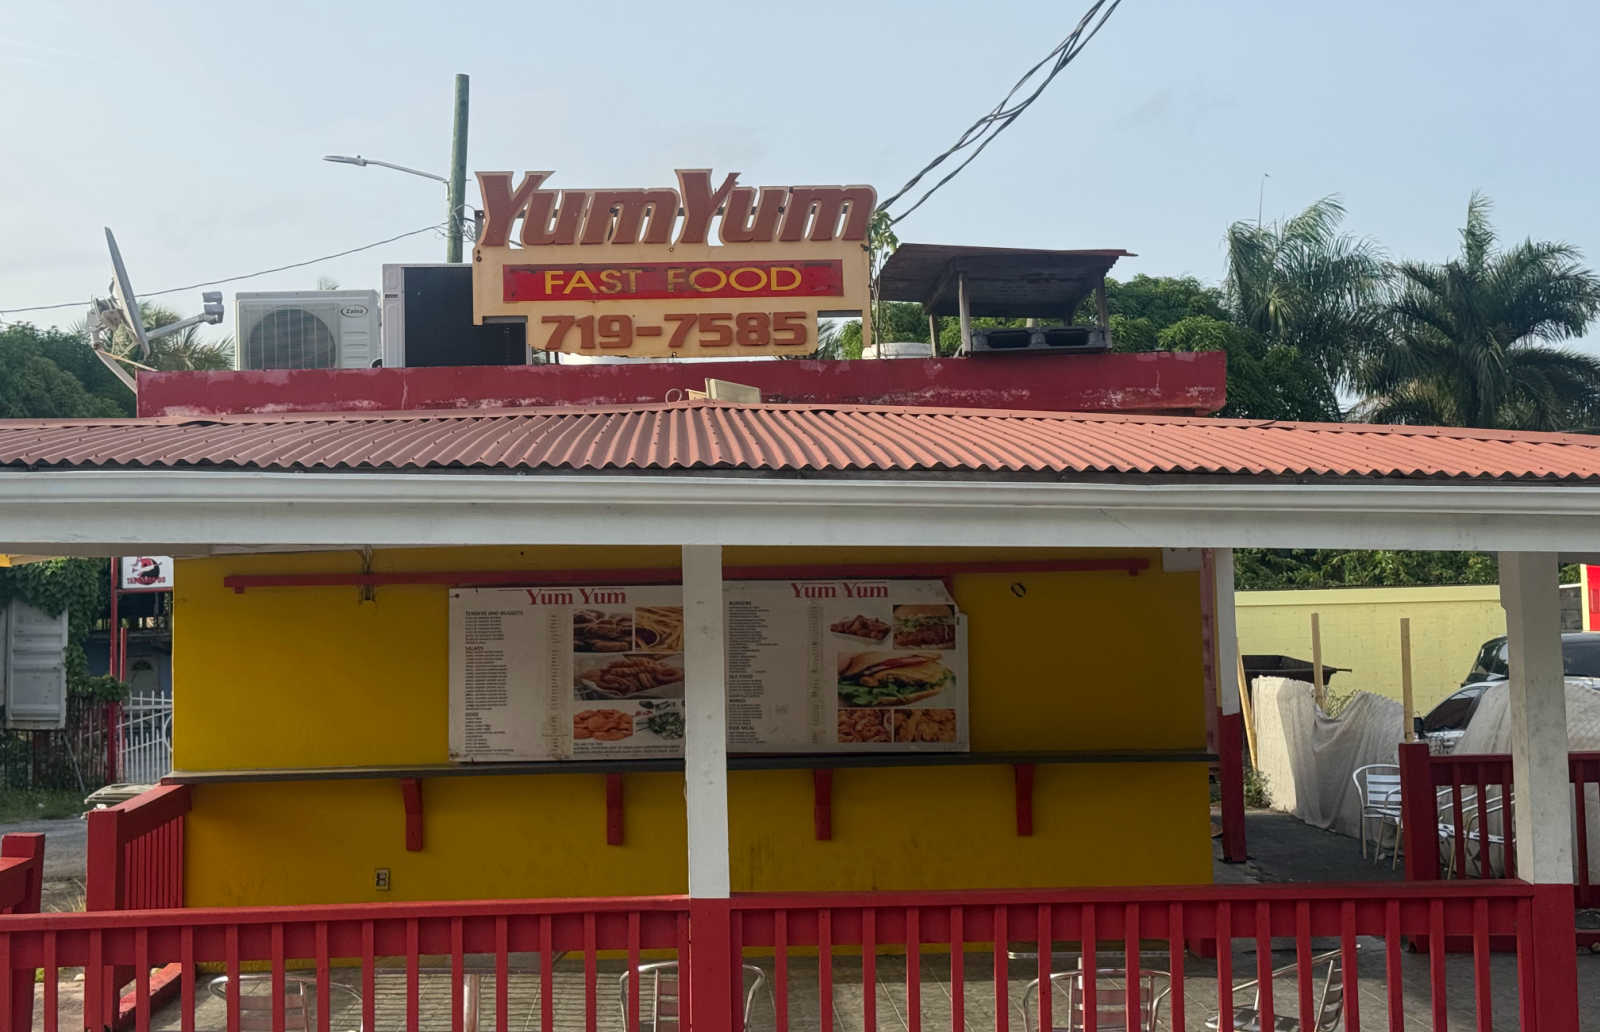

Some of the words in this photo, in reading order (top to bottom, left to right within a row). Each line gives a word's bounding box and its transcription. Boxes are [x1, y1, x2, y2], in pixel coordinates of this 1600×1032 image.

[544, 269, 641, 295] FAST
[667, 266, 802, 294] FOOD
[541, 312, 808, 350] 719-7585
[526, 588, 573, 605] Yum
[579, 588, 626, 605] Yum
[791, 582, 836, 598] Yum
[842, 582, 889, 598] Yum
